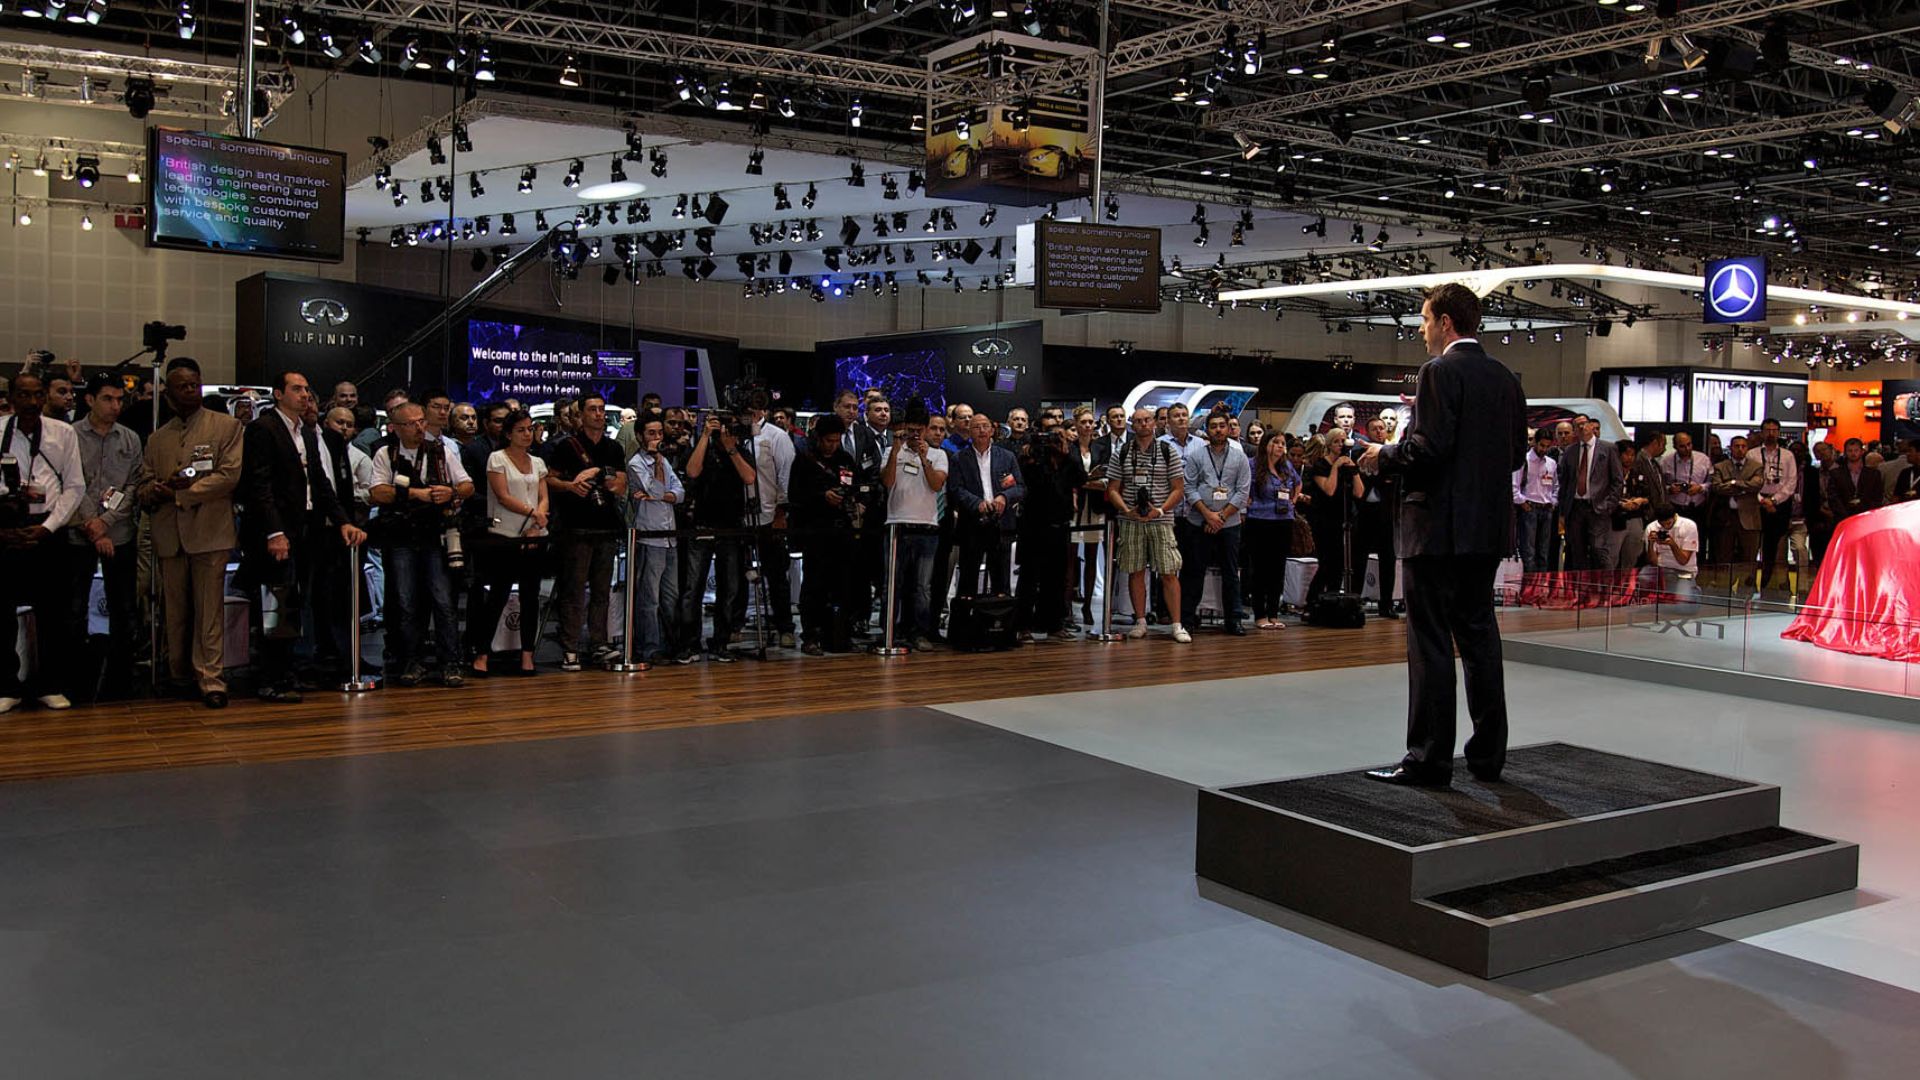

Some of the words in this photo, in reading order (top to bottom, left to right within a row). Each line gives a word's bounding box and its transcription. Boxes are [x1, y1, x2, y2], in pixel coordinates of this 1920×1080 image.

[166, 135, 216, 150] special,
[220, 142, 286, 160] something
[165, 169, 212, 186] leading
[216, 178, 290, 196] engineering
[294, 186, 316, 197] and
[210, 165, 253, 178] design
[257, 171, 280, 181] and
[284, 174, 330, 187] market-
[164, 182, 247, 200] technologies
[259, 194, 319, 209] combined
[163, 195, 190, 205] with
[195, 197, 249, 213] bespoke
[252, 204, 311, 220] customer
[164, 208, 211, 220] service
[215, 212, 239, 223] and
[243, 215, 287, 230] quality.
[1076, 244, 1102, 255] design
[1104, 247, 1120, 255] and
[1048, 252, 1078, 262] leading
[1080, 254, 1126, 265] engineering
[1127, 257, 1143, 265] and
[1048, 261, 1099, 271] technologies
[1106, 265, 1144, 273] combined
[1048, 279, 1078, 287] service
[1079, 280, 1095, 288] and
[1067, 271, 1101, 281] bespoke
[1102, 273, 1138, 281] customer
[284, 331, 364, 347] INFINITI
[472, 347, 517, 361] Welcome
[519, 350, 530, 362] to
[531, 350, 548, 363] the
[493, 364, 511, 377] Our
[513, 368, 540, 380] press
[541, 370, 592, 380] conerence
[958, 364, 1026, 374] INFI
[512, 382, 540, 394] about
[542, 384, 553, 395] to
